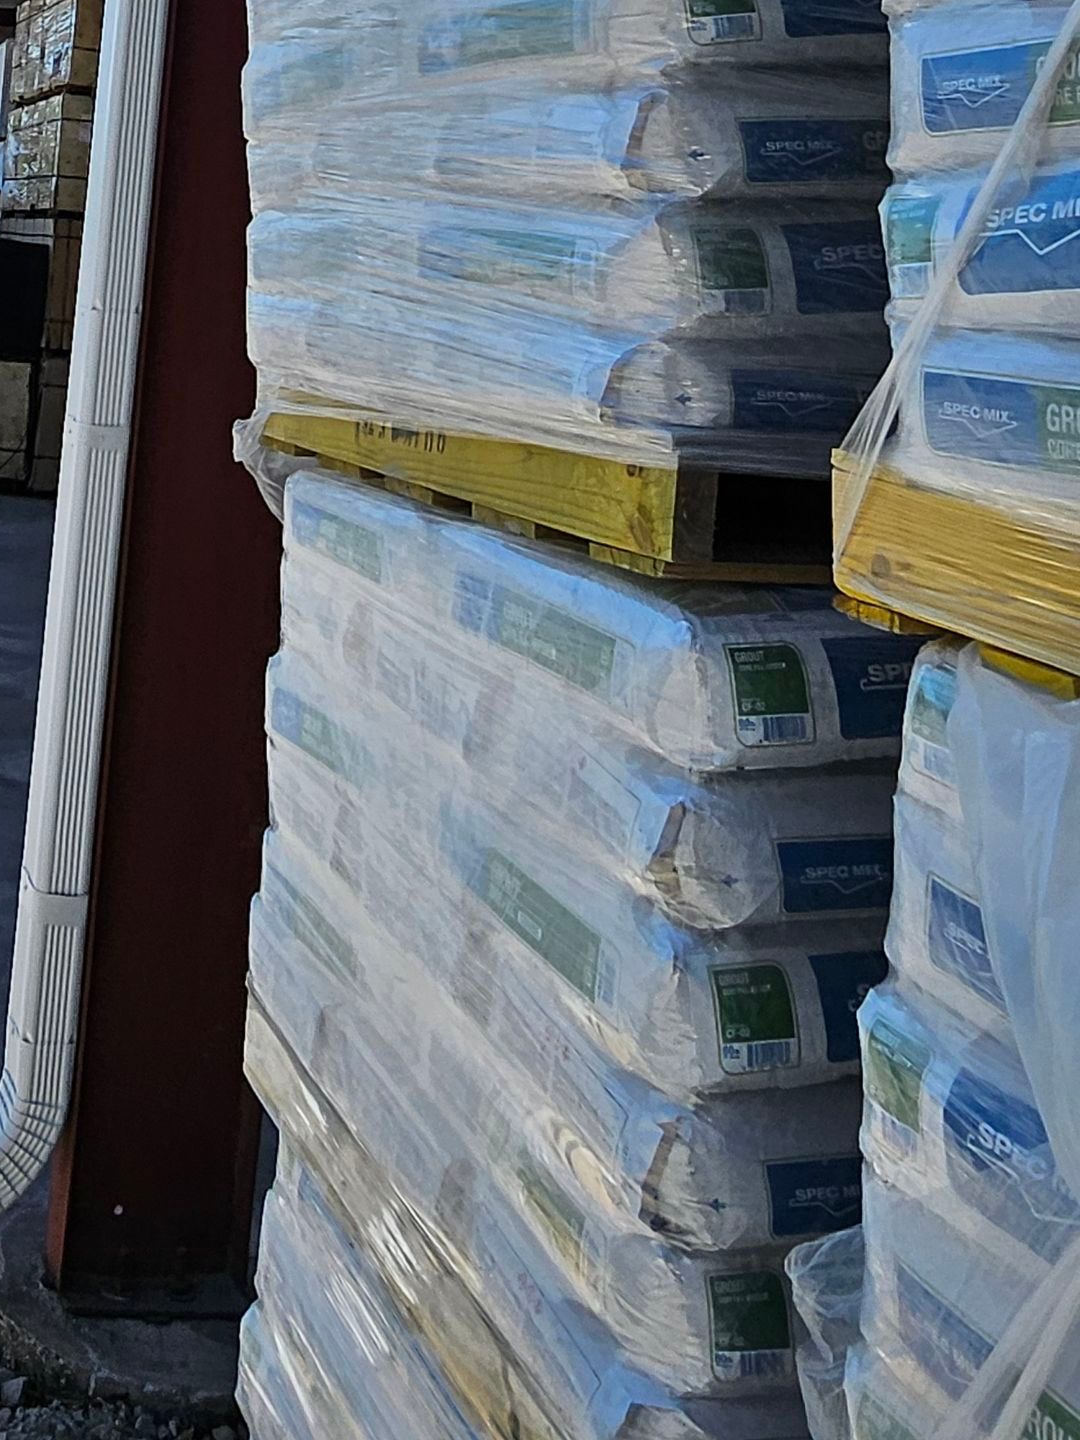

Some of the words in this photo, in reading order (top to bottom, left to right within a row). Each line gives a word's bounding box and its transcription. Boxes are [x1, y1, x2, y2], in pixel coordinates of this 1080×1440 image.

[941, 78, 974, 95] SPEC
[765, 140, 805, 152] SPEC
[986, 205, 1047, 228] SPEC
[1051, 199, 1080, 221] MI
[821, 244, 882, 262] SPEC
[756, 390, 793, 402] SPEC
[943, 401, 980, 419] SPEC
[983, 407, 1010, 424] MIX
[805, 866, 849, 879] SPEC
[978, 1121, 1049, 1181] SPEC
[795, 1187, 836, 1203] SPEC
[839, 1187, 862, 1201] MI
